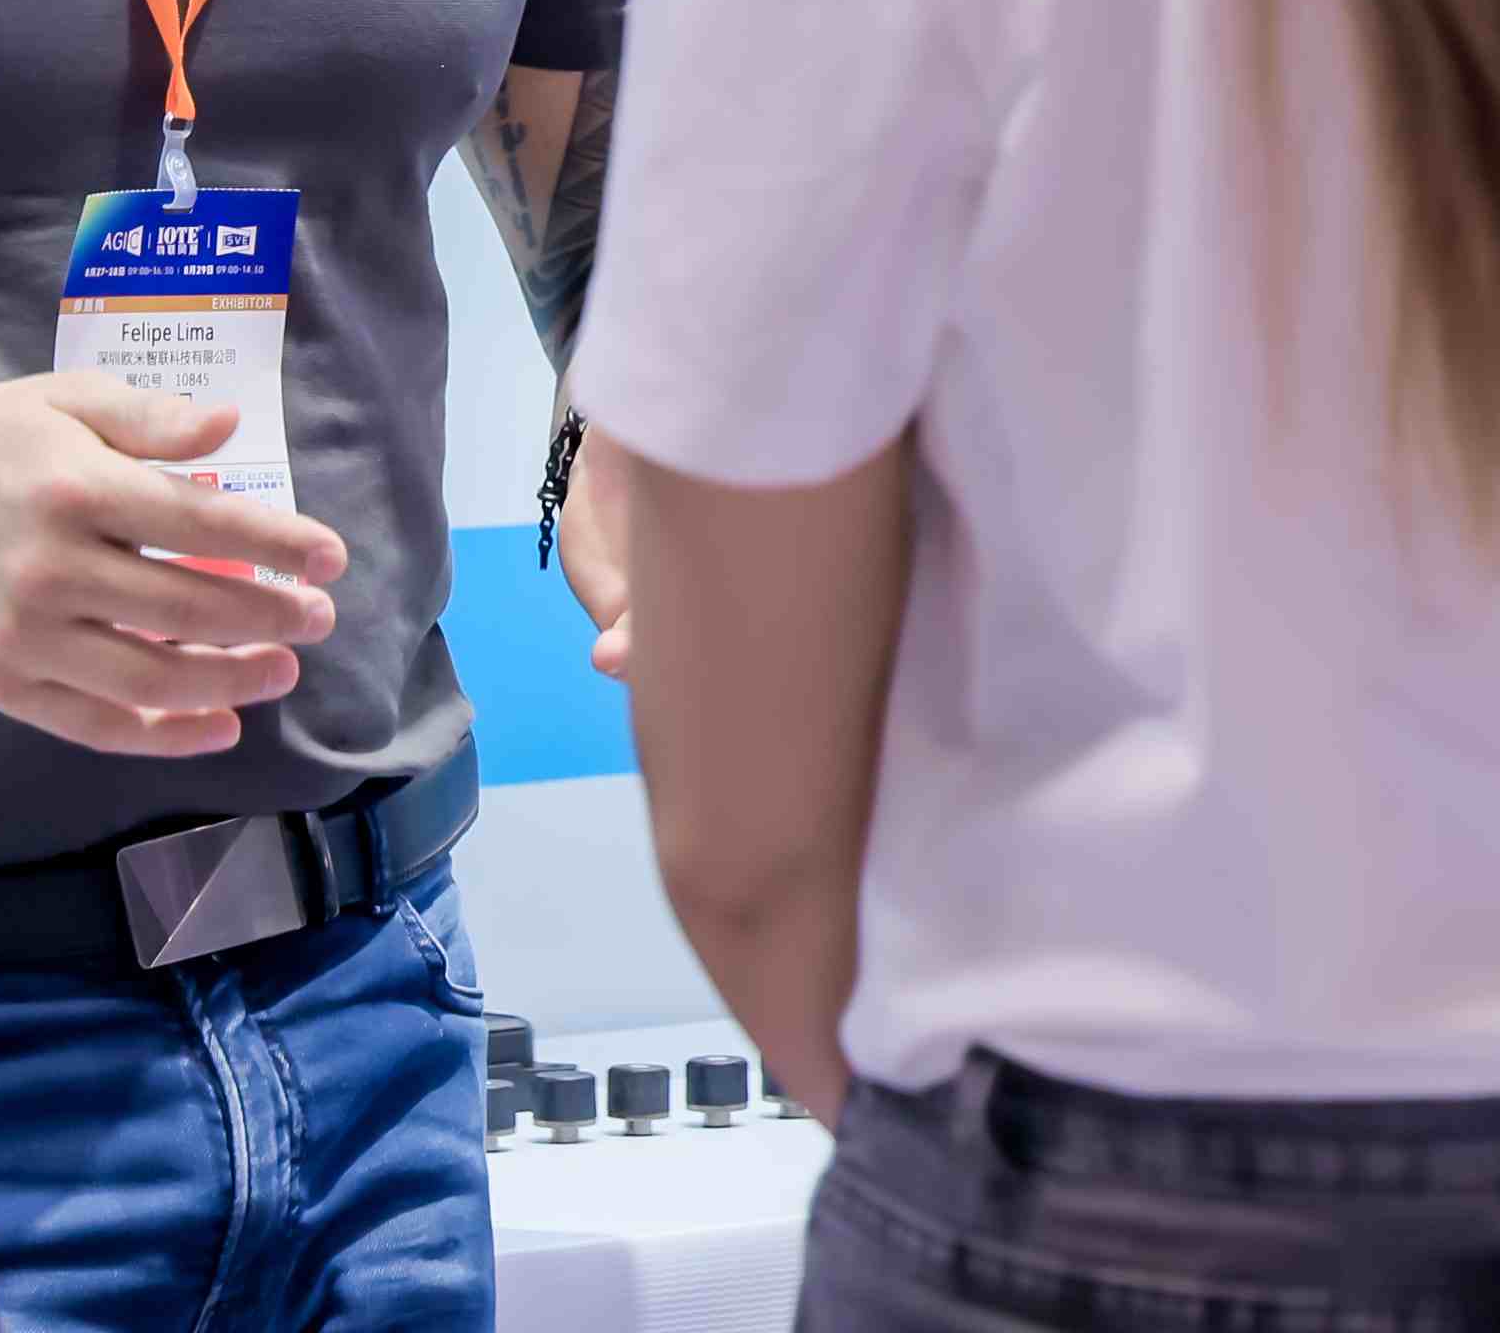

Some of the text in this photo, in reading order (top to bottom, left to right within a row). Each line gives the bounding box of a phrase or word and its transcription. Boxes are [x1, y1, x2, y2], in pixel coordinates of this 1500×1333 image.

[157, 226, 200, 244] IOTE
[211, 297, 273, 310] EXHIBITOR
[122, 323, 214, 346] Felipe Lima
[175, 373, 209, 387] 10845
